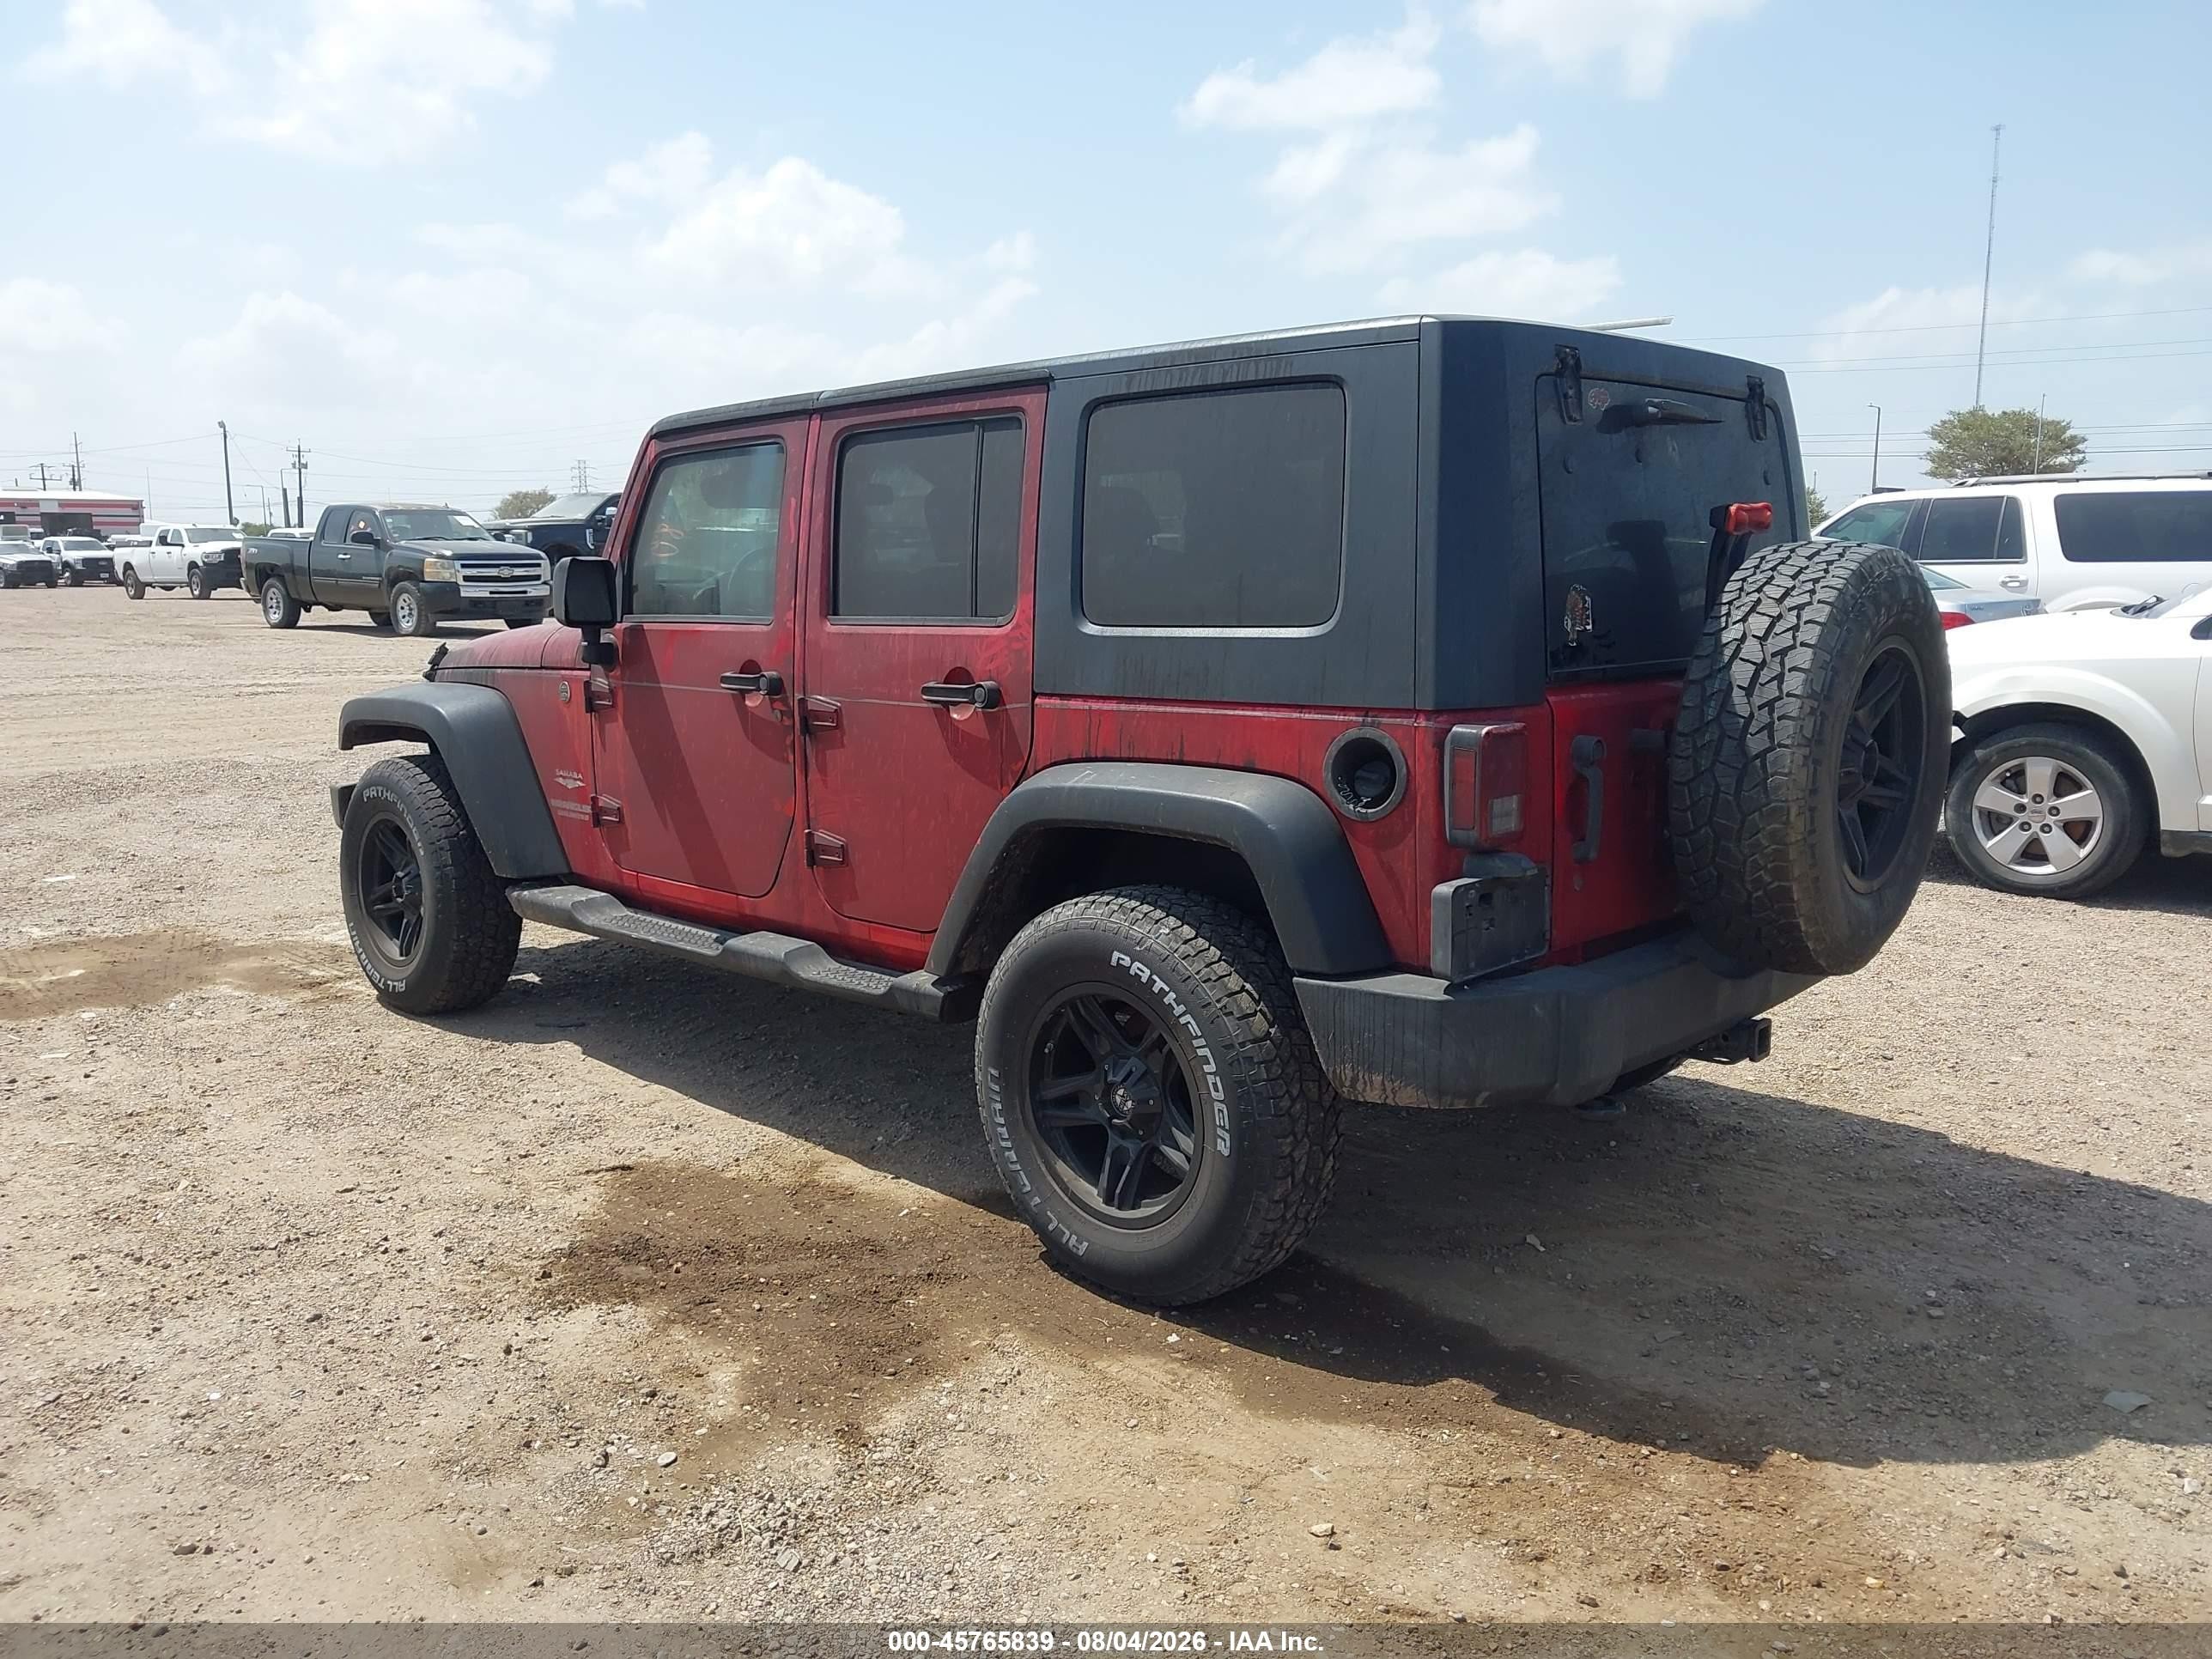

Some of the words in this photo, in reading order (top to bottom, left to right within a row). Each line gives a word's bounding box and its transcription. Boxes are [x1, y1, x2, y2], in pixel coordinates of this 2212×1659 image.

[555, 769, 584, 781] SAHARA
[362, 785, 425, 857] PATHFINDER
[348, 921, 386, 990] TERRAIN
[386, 979, 406, 993] ALL
[1109, 950, 1232, 1158] PATHFINDER
[1045, 1209, 1090, 1257] ALL
